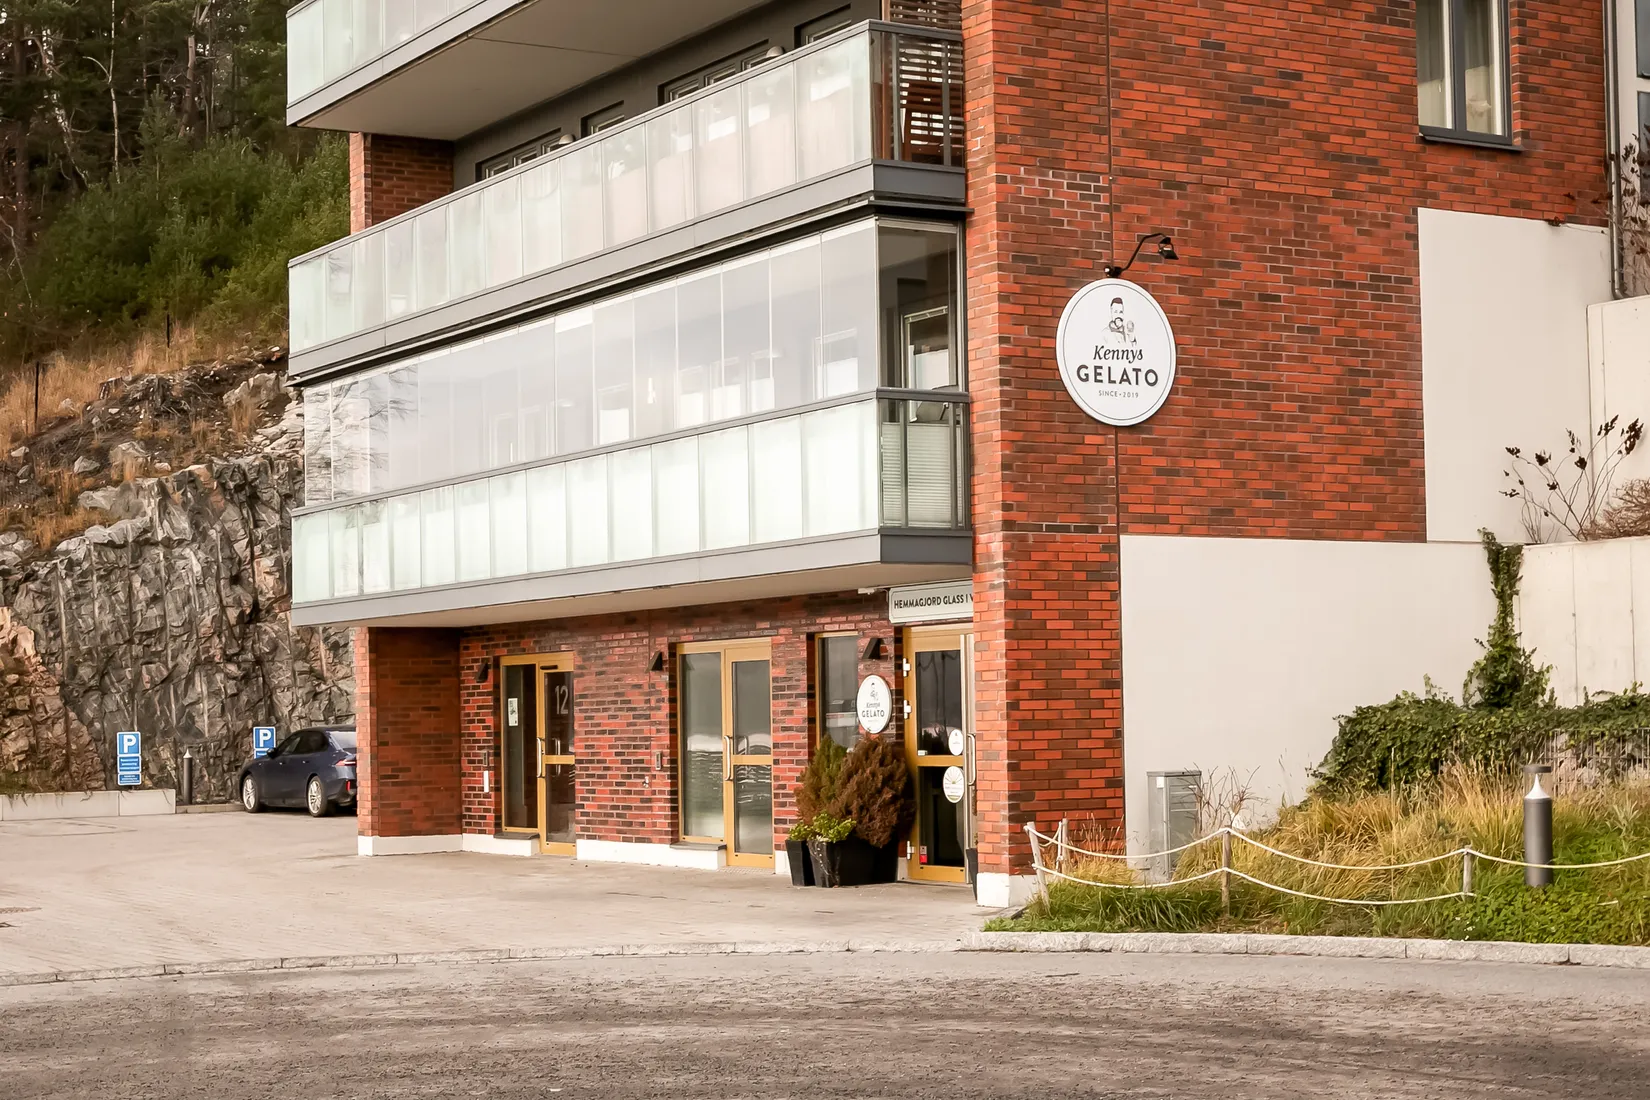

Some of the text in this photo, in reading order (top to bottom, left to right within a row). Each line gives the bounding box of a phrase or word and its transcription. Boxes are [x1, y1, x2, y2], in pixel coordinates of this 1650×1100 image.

[1093, 345, 1144, 364] Kennys
[1076, 364, 1159, 387] GELATO
[894, 597, 942, 609] HEMMAGJORD
[943, 594, 964, 605] GLASS
[555, 685, 568, 715] 12
[861, 709, 885, 718] GELATO
[123, 734, 137, 754] P
[259, 729, 272, 748] P
